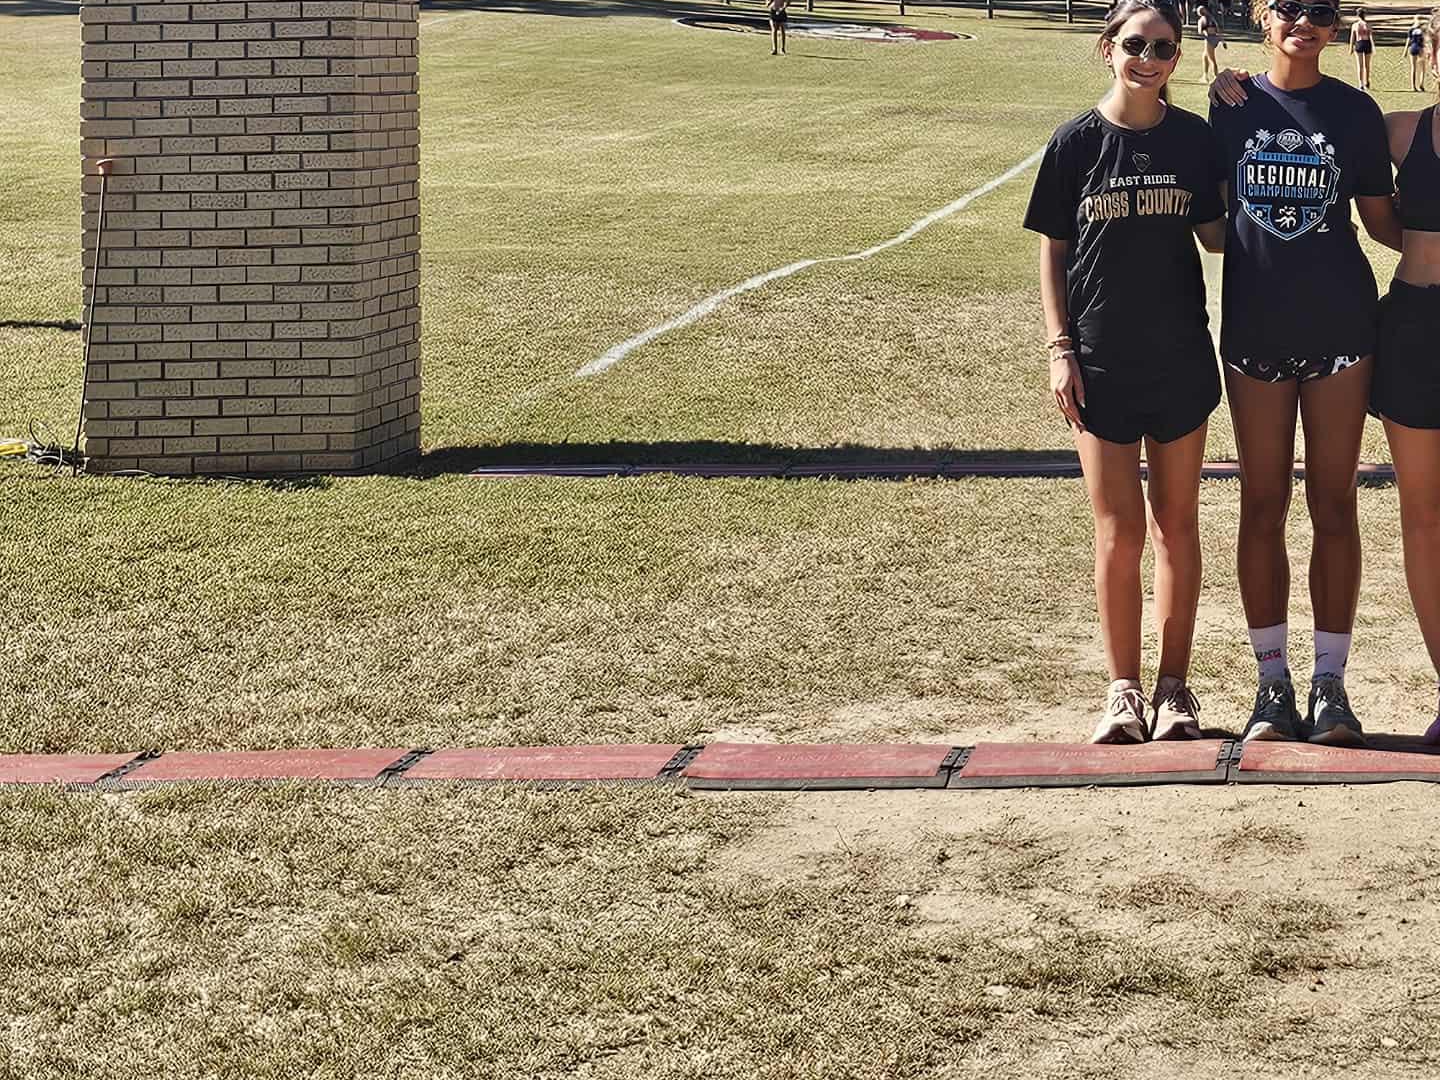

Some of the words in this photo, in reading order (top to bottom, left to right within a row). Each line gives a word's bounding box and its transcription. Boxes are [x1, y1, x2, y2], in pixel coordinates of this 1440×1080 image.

[1109, 175, 1141, 188] EAST
[1143, 174, 1177, 185] RIDGE
[1247, 164, 1327, 188] REGIONAL
[1248, 184, 1325, 199] CHAMPIONSHIPS
[1084, 190, 1130, 222] CROSS
